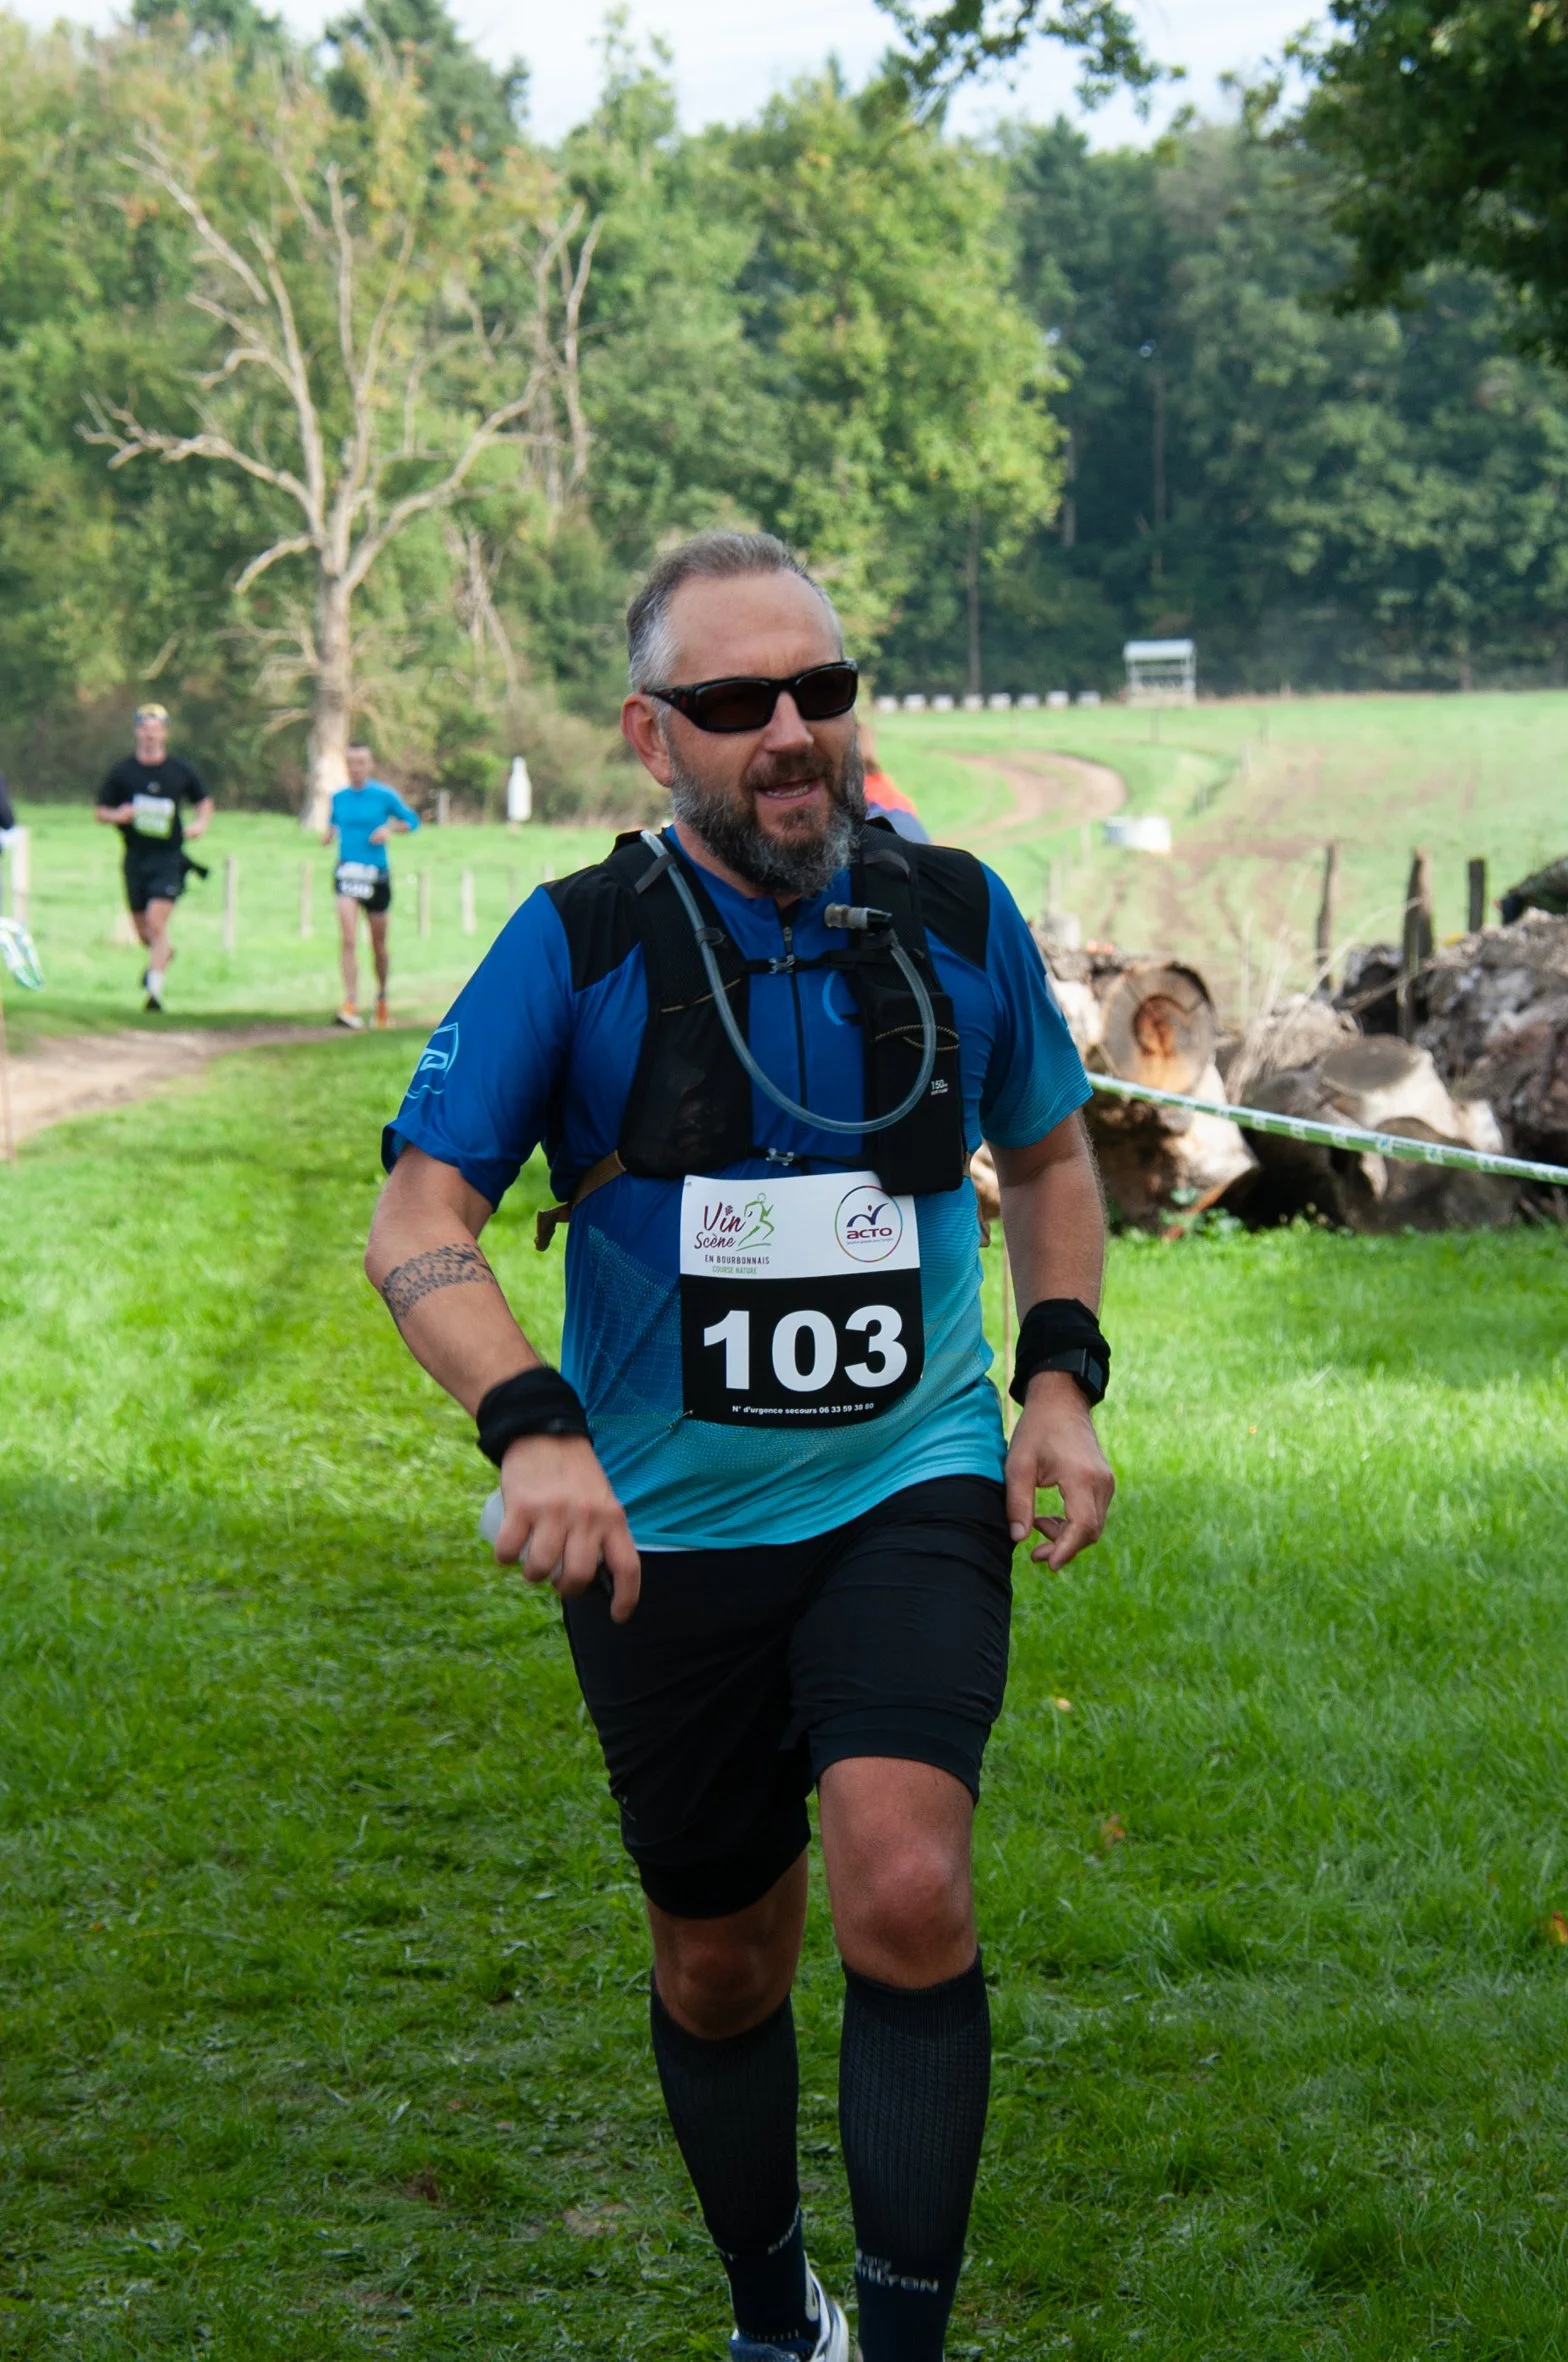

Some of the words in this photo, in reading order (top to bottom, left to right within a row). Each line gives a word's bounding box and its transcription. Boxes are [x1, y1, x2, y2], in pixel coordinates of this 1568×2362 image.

[694, 1231, 736, 1250] Scène
[704, 1254, 714, 1263] EN
[716, 1255, 770, 1265] BOURBONNAIS
[712, 1265, 733, 1274] COURSE
[735, 1266, 757, 1275] NATURE
[703, 1304, 908, 1393] 103
[743, 1405, 783, 1416] d'urgence
[819, 1406, 829, 1414] 06
[831, 1405, 841, 1414] 33
